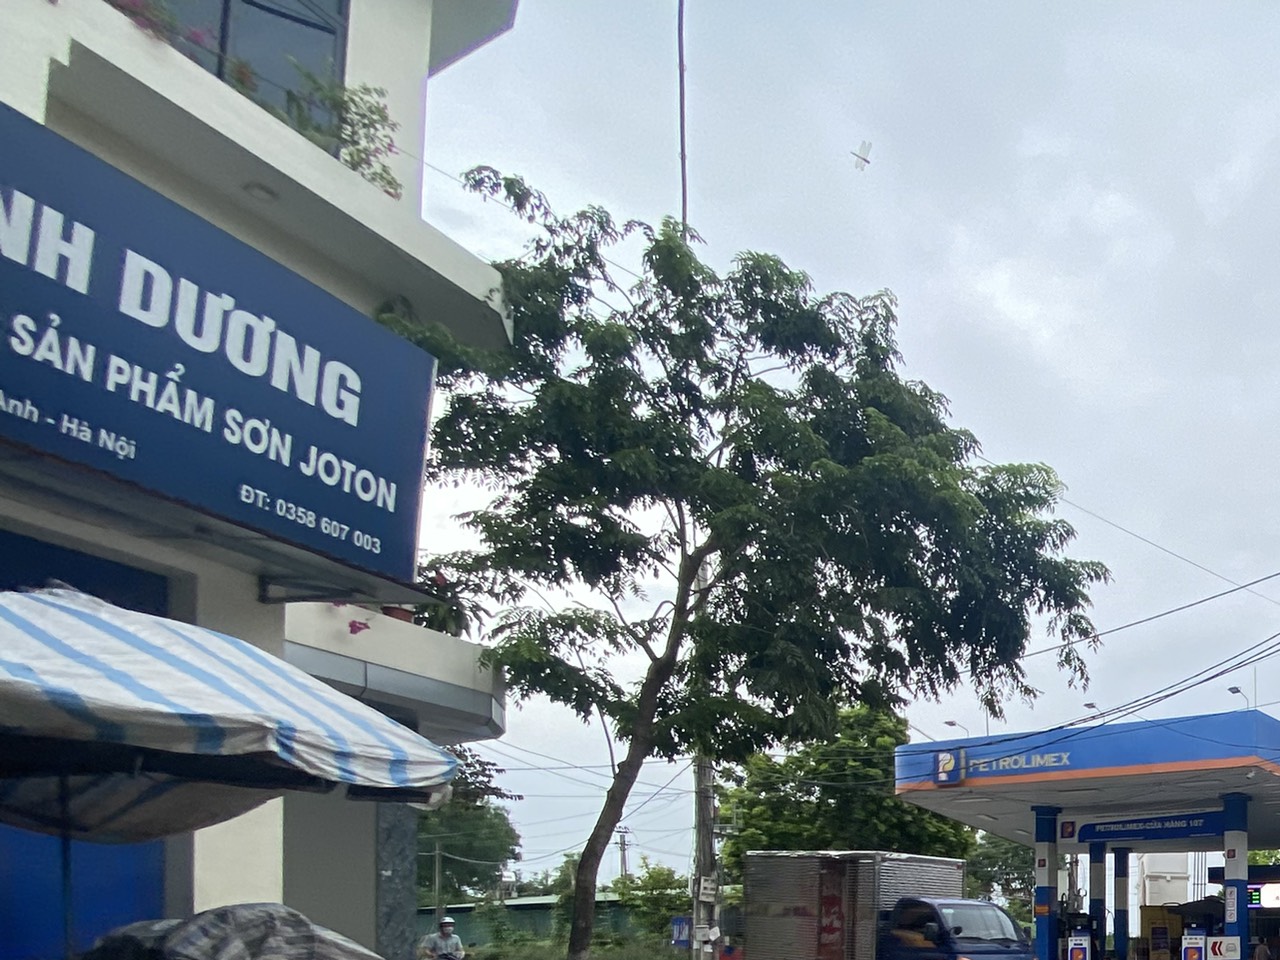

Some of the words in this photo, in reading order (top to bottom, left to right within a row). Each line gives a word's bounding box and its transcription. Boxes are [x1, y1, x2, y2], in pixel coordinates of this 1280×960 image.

[119, 248, 362, 427] DƯƠNG
[9, 313, 96, 383] SẢN
[106, 363, 214, 433] PHẨM
[223, 408, 292, 467] SƠN
[299, 445, 397, 513] JOTON
[61, 413, 92, 443] Hà
[98, 428, 136, 460] Nội
[240, 483, 271, 511] ĐT:
[276, 499, 316, 528] 0358
[321, 516, 350, 540] 607
[354, 530, 381, 554] 003
[968, 752, 1072, 772] PETROLIMEX
